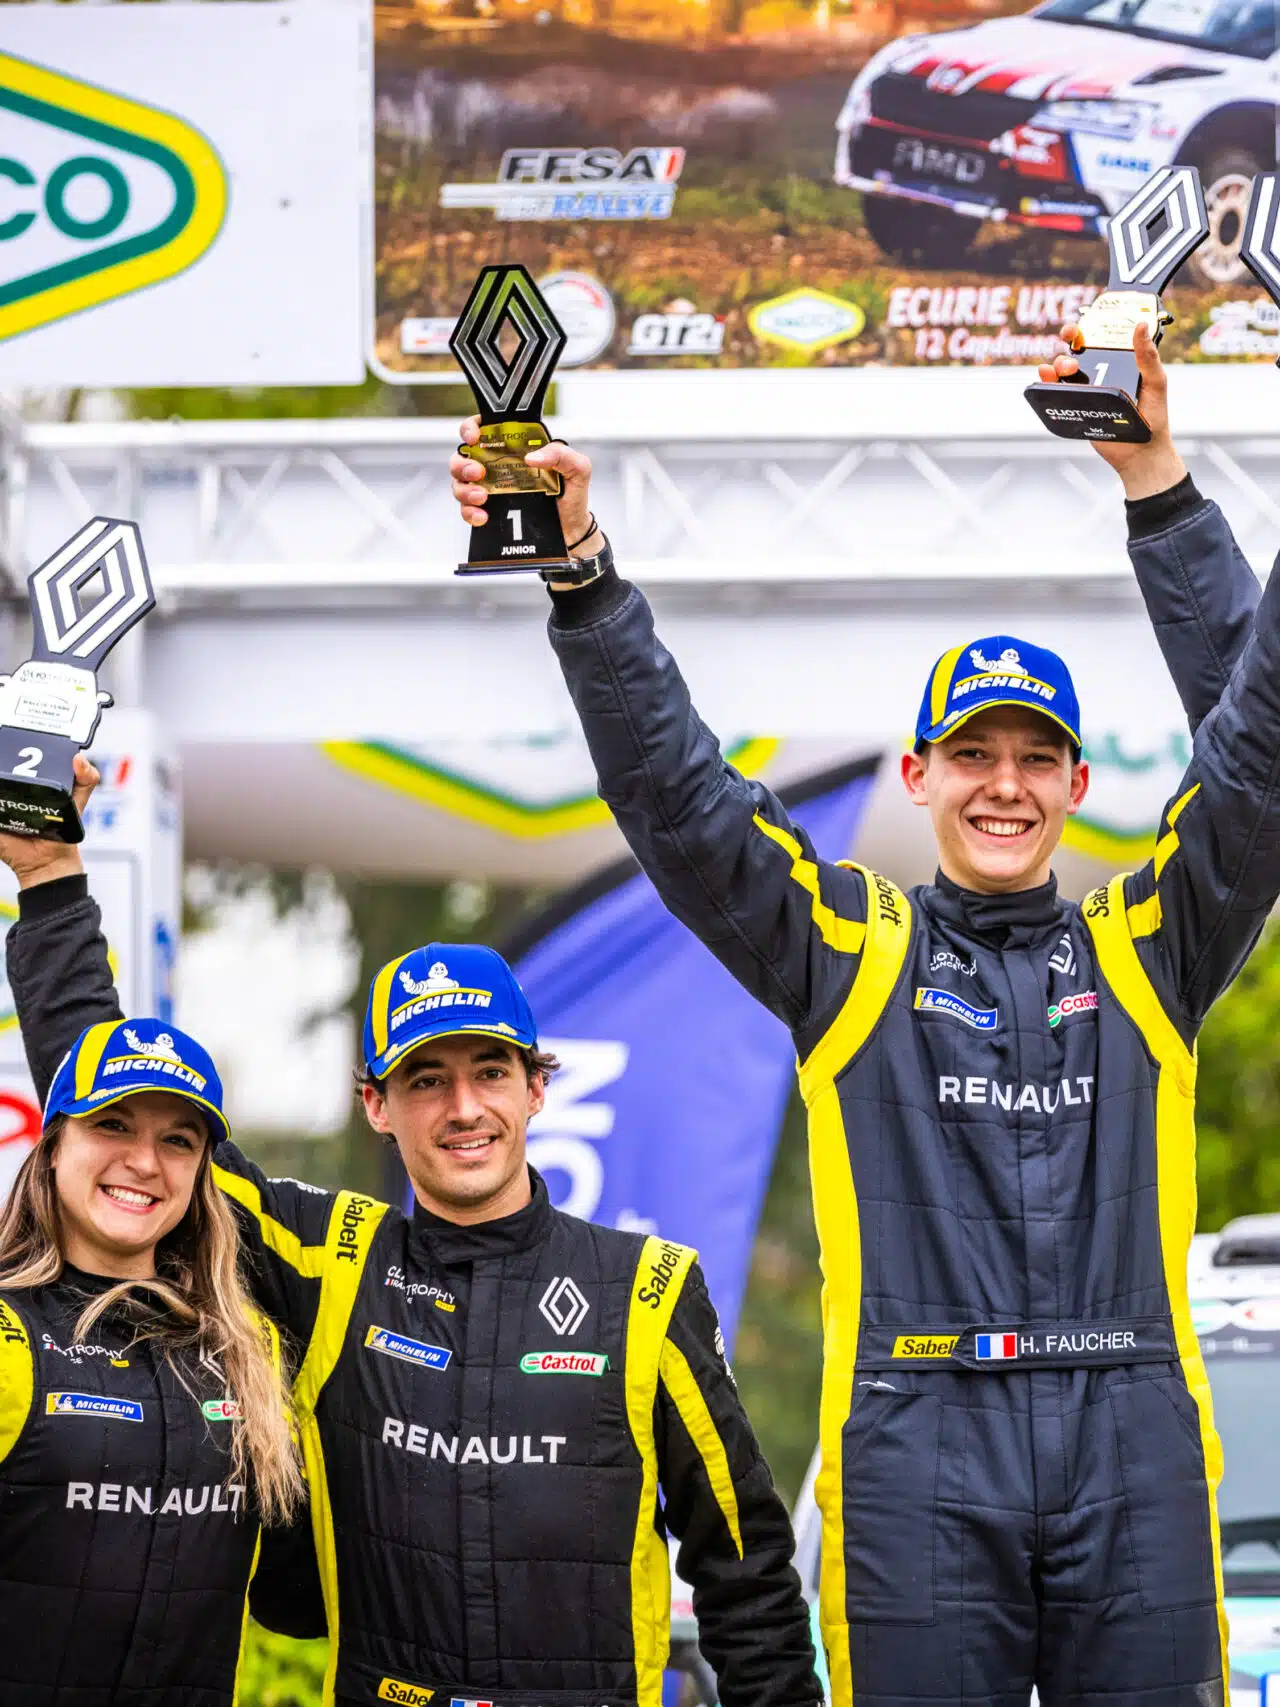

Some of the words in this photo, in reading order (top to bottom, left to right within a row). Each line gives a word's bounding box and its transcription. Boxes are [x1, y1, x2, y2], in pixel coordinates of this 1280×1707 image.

[506, 154, 655, 180] FFSA
[887, 286, 1012, 328] ECURIE
[1092, 362, 1110, 386] 1
[505, 509, 523, 541] 1
[501, 545, 536, 556] JUNIOR
[952, 676, 1057, 701] MICHELIN
[12, 746, 43, 778] 2
[391, 993, 492, 1032] MICHELIN
[935, 996, 990, 1025] MICHELIN
[103, 1059, 206, 1092] MICHELIN
[939, 1075, 1094, 1114] RENAULT
[336, 1196, 374, 1263] Sabelt
[638, 1242, 683, 1310] Sabelt
[387, 1340, 441, 1362] MICHELIN
[1020, 1336, 1040, 1353] H.
[1046, 1331, 1137, 1353] FAUCHER
[541, 1353, 596, 1373] Castrol
[75, 1399, 135, 1416] MICHELIN
[381, 1416, 567, 1464] RENAULT
[65, 1481, 246, 1516] RENAULT
[385, 1682, 429, 1707] Sabe
